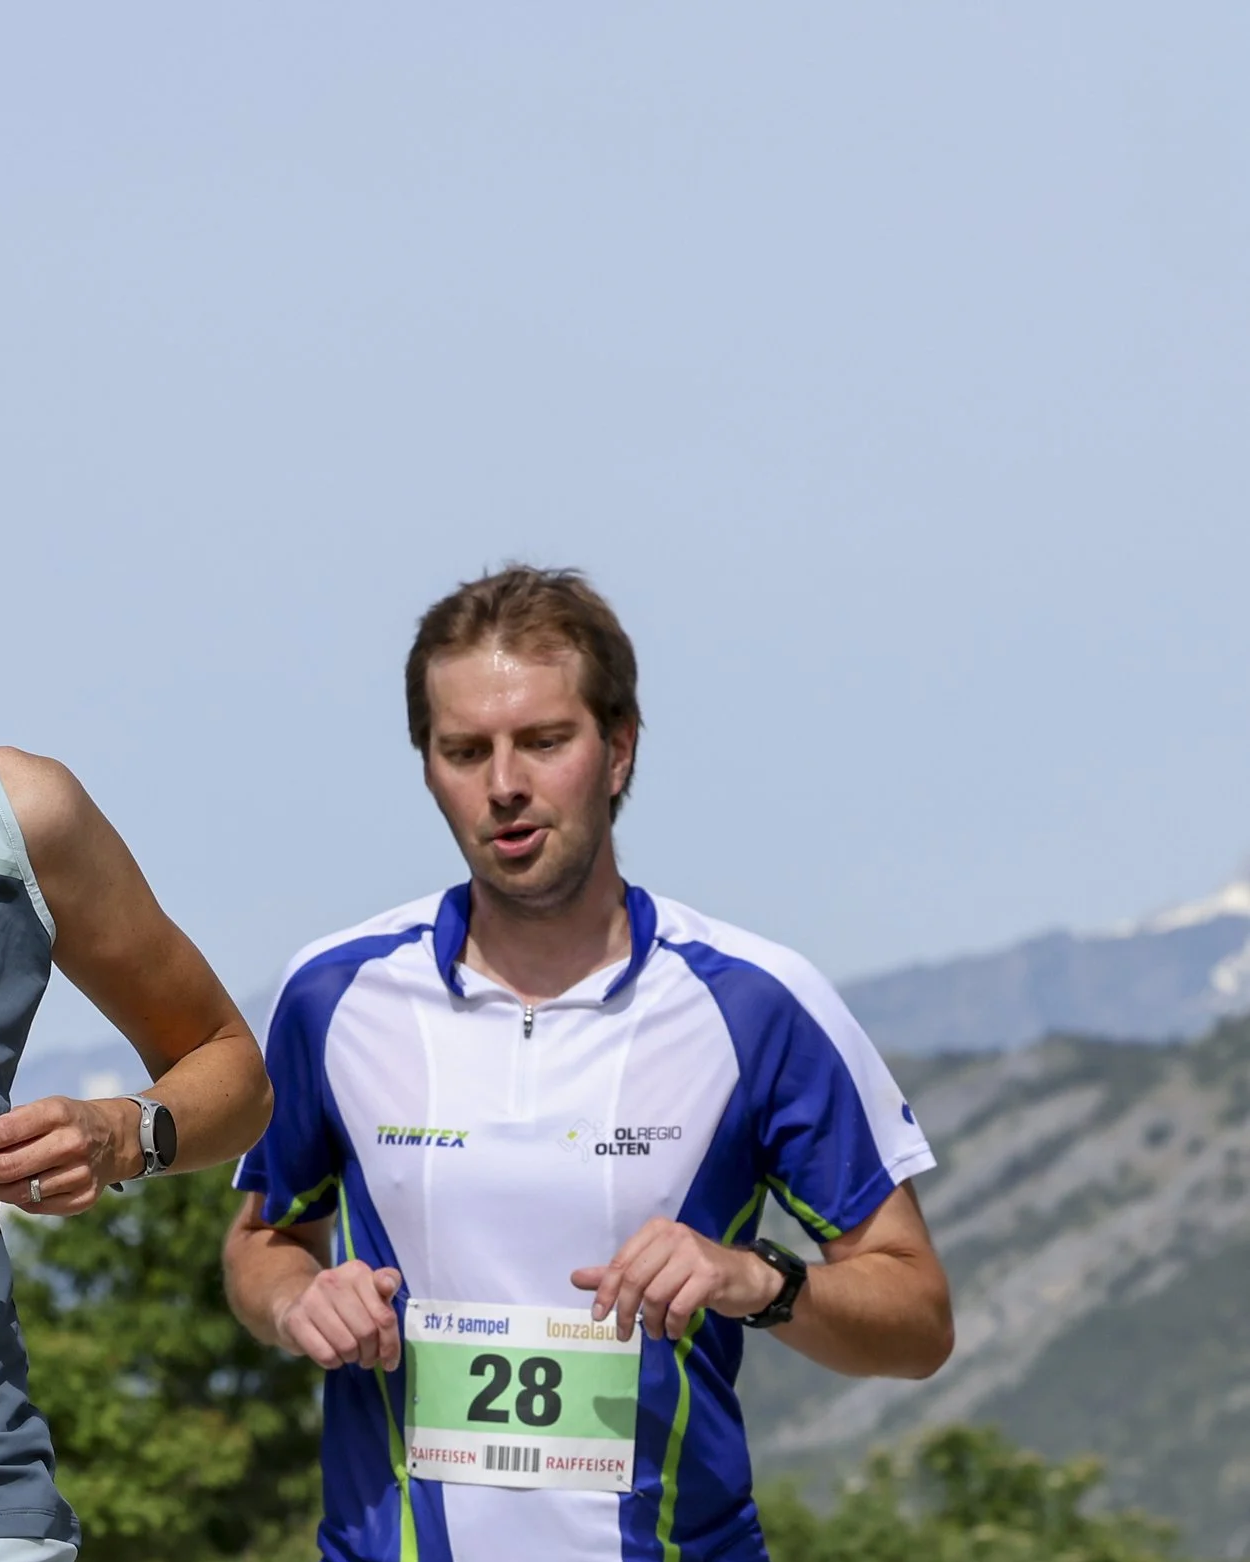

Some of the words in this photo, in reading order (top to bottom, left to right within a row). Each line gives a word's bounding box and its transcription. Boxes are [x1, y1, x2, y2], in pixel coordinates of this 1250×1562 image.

[376, 1125, 470, 1148] TRIMTEX
[594, 1142, 650, 1156] OLTEN
[424, 1312, 442, 1329] stv
[457, 1317, 510, 1336] gampel
[546, 1317, 616, 1340] lonzalau
[466, 1353, 563, 1427] 28
[410, 1445, 477, 1464] RAIFFEISEN
[545, 1456, 625, 1473] RAIFFEISEN
